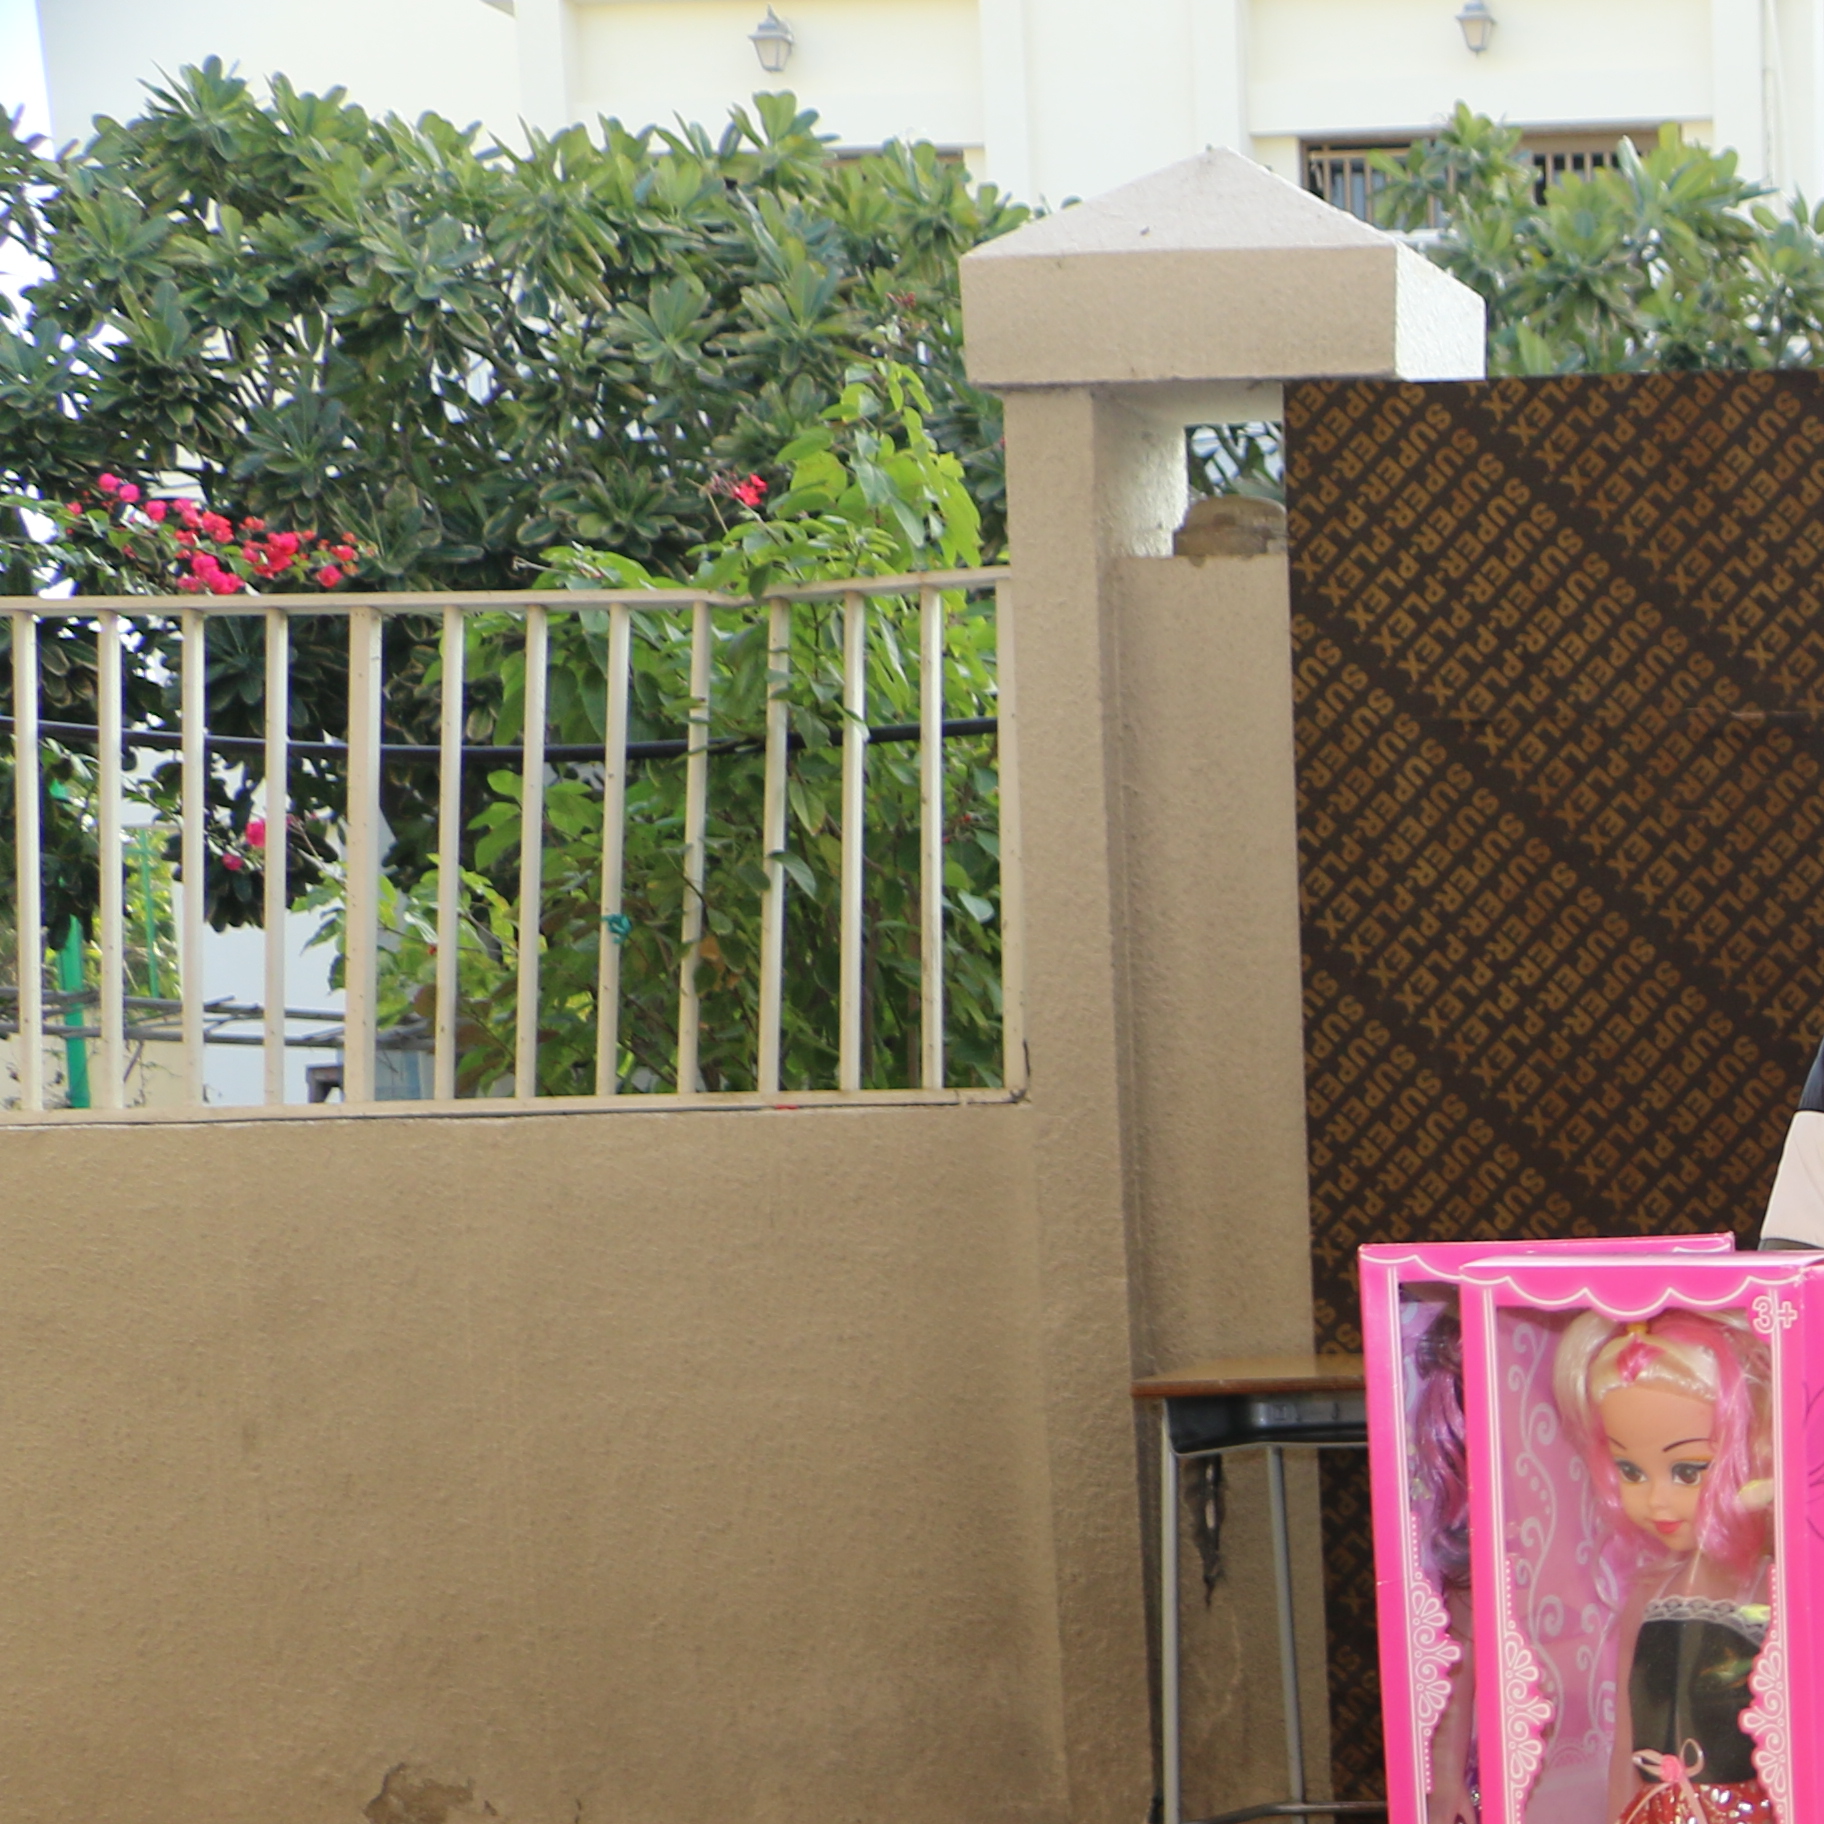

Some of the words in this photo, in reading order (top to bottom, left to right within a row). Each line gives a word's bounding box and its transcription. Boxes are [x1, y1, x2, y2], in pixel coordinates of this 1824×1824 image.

[1291, 398, 1456, 583] SUPER-PLEX
[1315, 423, 1482, 608] SUPER-PLEX
[1341, 448, 1509, 633] SUPER-PLEX
[1610, 372, 1778, 546] SUPER-PLEX
[1636, 387, 1804, 571] SUPER-PLEX
[1367, 473, 1535, 658] SUPER-PLEX
[1393, 498, 1561, 683] SUPER-PLEX
[1420, 523, 1587, 708] SUPER-PLEX
[1446, 548, 1614, 733] SUPER-PLEX
[1472, 573, 1640, 758] SUPER-PLEX
[1498, 598, 1666, 783] SUPER-PLEX
[1525, 623, 1692, 808] SUPER-PLEX
[1551, 648, 1719, 832] SUPER-PLEX
[1310, 757, 1478, 942] SUPER-PLEX
[1577, 673, 1745, 857] SUPER-PLEX
[1603, 697, 1771, 882] SUPER-PLEX
[1630, 722, 1797, 907] SUPER-PLEX
[1656, 747, 1823, 932] SUPER-PLEX
[1336, 782, 1504, 967] SUPER-PLEX
[1362, 807, 1530, 992] SUPER-PLEX
[1388, 832, 1556, 1016] SUPER-PLEX
[1414, 856, 1582, 1041] SUPER-PLEX
[1440, 881, 1608, 1066] SUPER-PLEX
[1466, 906, 1634, 1090] SUPER-PLEX
[1493, 930, 1660, 1115] SUPER-PLEX
[1519, 955, 1686, 1140] SUPER-PLEX
[1545, 980, 1712, 1164] SUPER-PLEX
[1571, 1004, 1738, 1189] SUPER-PLEX
[1597, 1029, 1764, 1214] SUPER-PLEX
[1623, 1053, 1790, 1238] SUPER-PLEX
[1316, 1087, 1473, 1272] SUPER-PLEX
[1752, 1296, 1798, 1335] 3+
